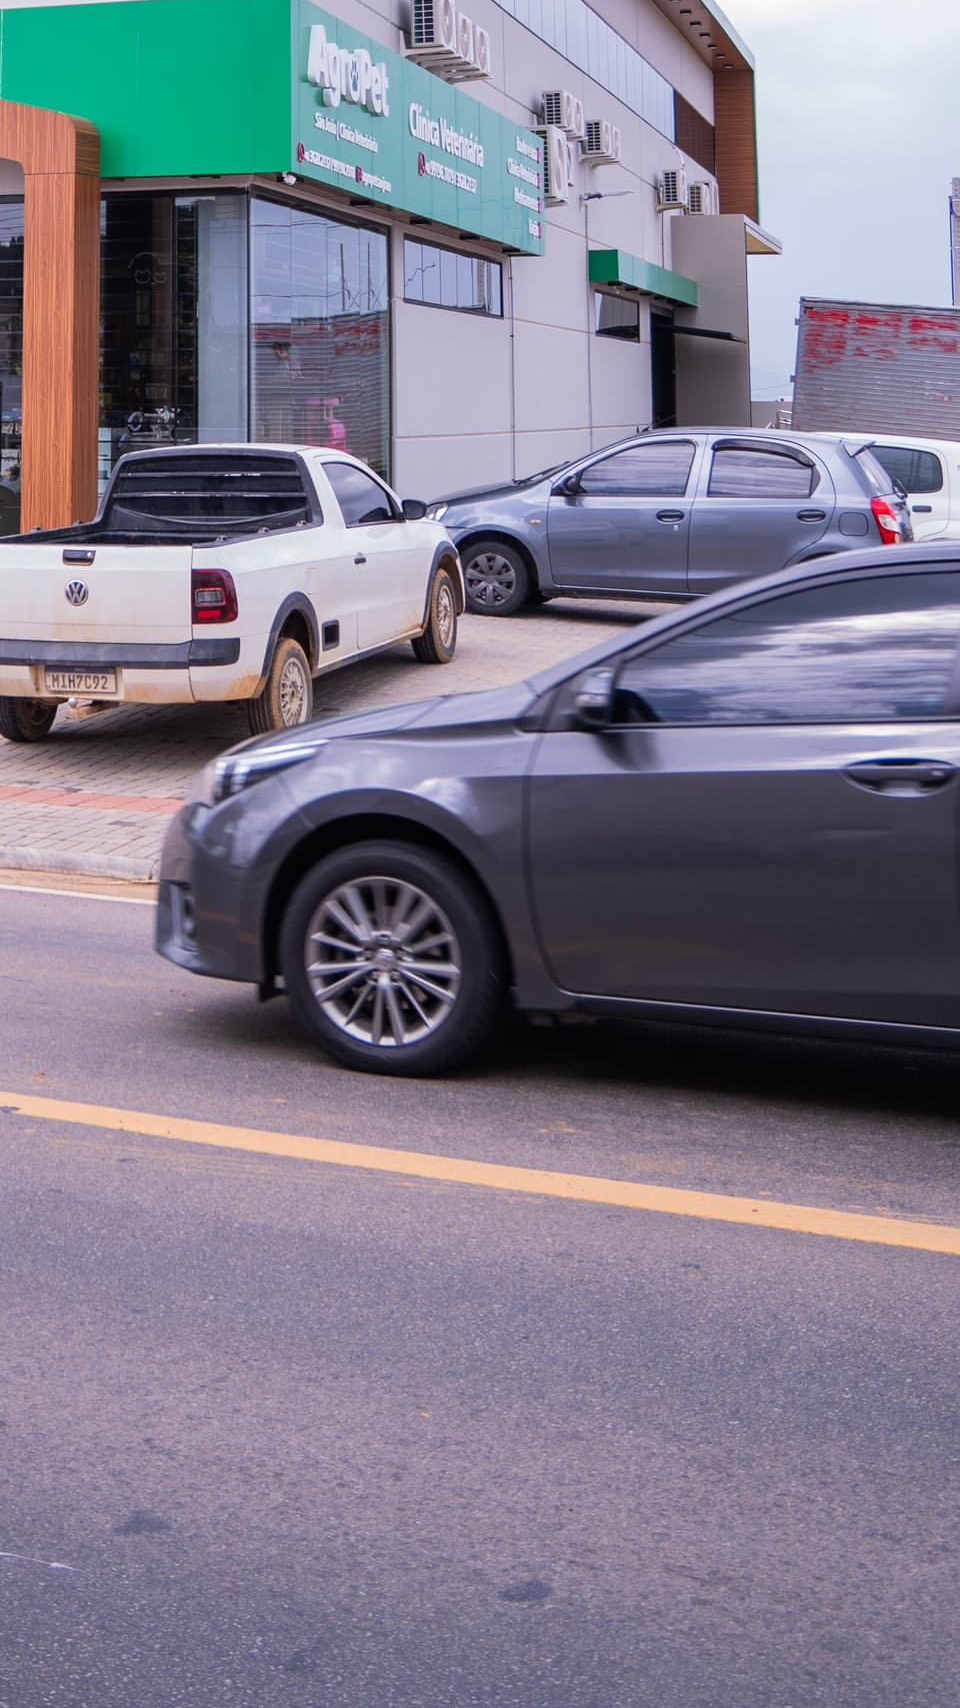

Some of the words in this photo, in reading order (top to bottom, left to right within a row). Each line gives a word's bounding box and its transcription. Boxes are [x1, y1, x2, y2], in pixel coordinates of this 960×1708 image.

[307, 24, 389, 117] AgroPet
[409, 103, 440, 147] Clínica
[440, 117, 484, 167] Veterinária
[51, 673, 108, 690] MIH7C92
